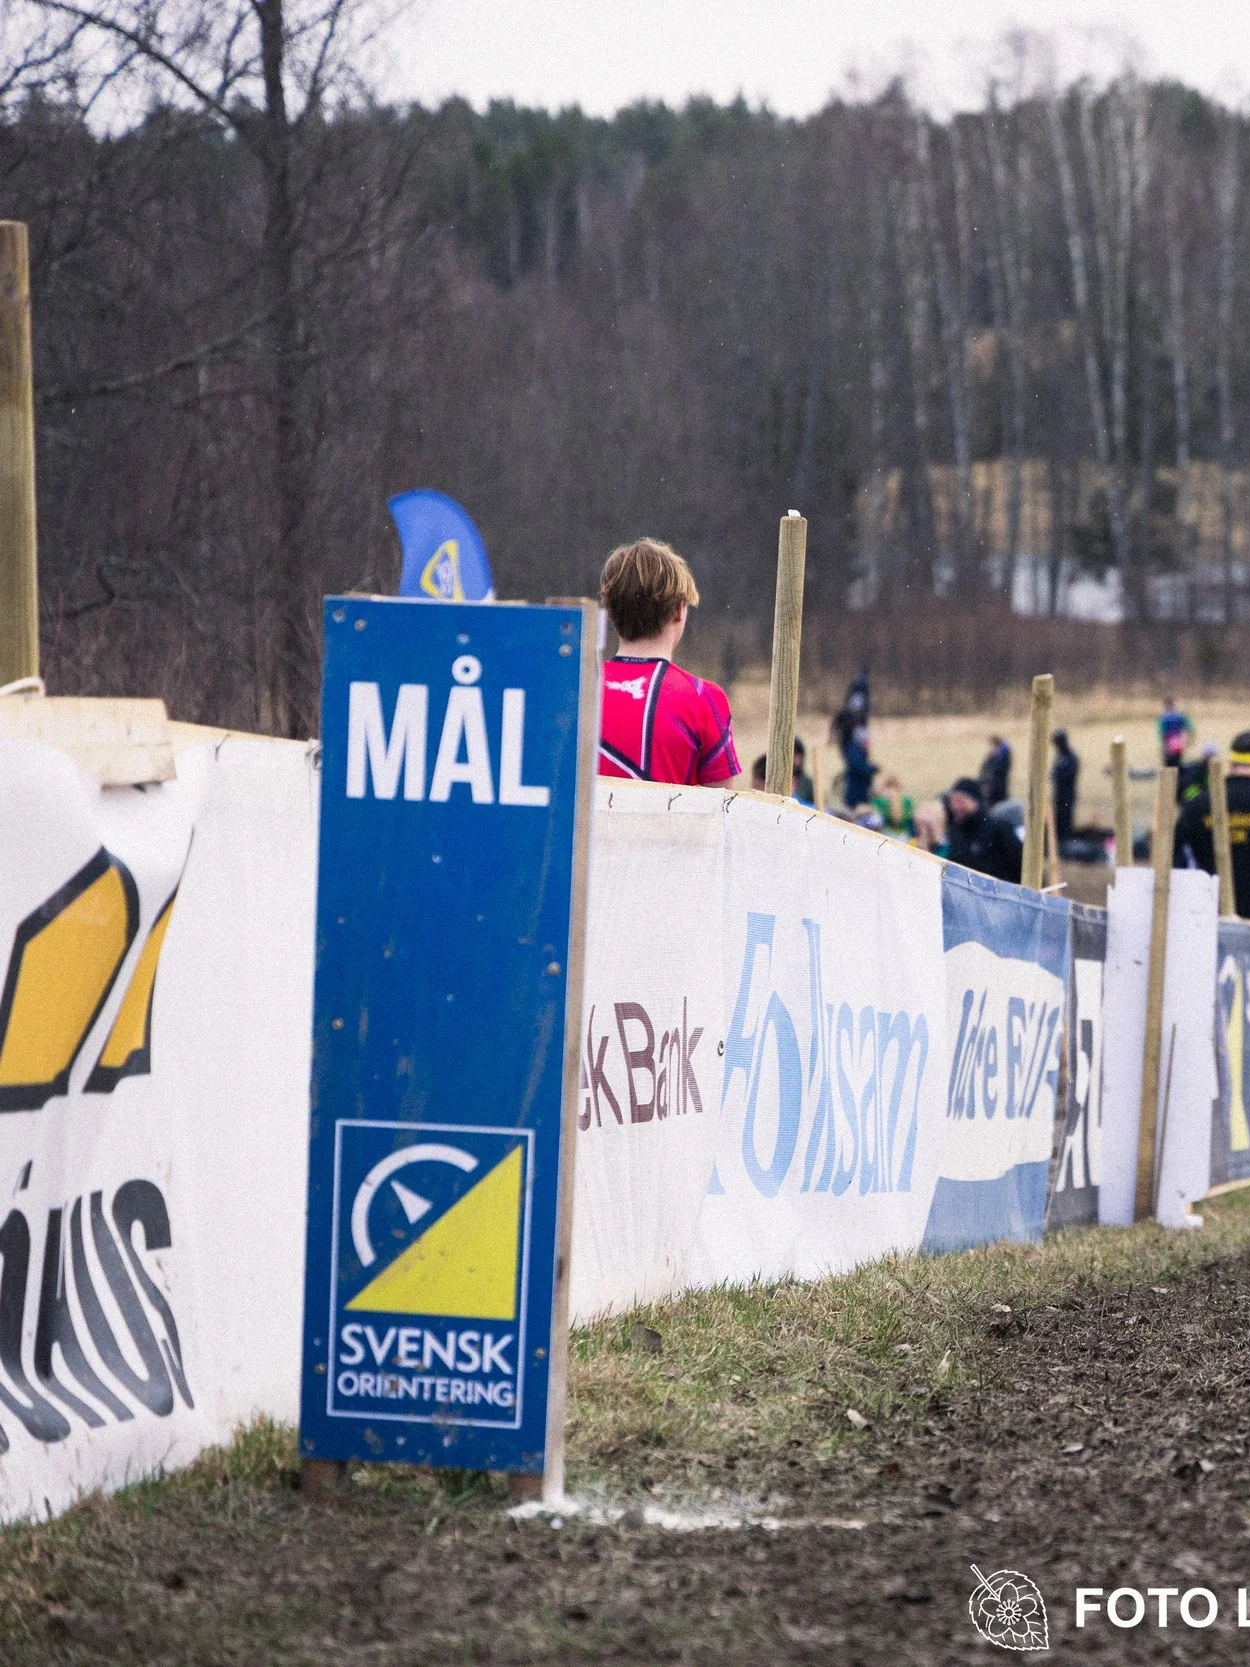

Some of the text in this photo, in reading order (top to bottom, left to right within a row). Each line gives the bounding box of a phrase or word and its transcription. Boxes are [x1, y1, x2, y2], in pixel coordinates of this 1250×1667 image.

[346, 655, 551, 807] MÅL
[614, 996, 705, 1124] Bank
[706, 911, 929, 1199] Folksam
[336, 1370, 516, 1408] ORIENTERING
[339, 1322, 516, 1376] SVENSK
